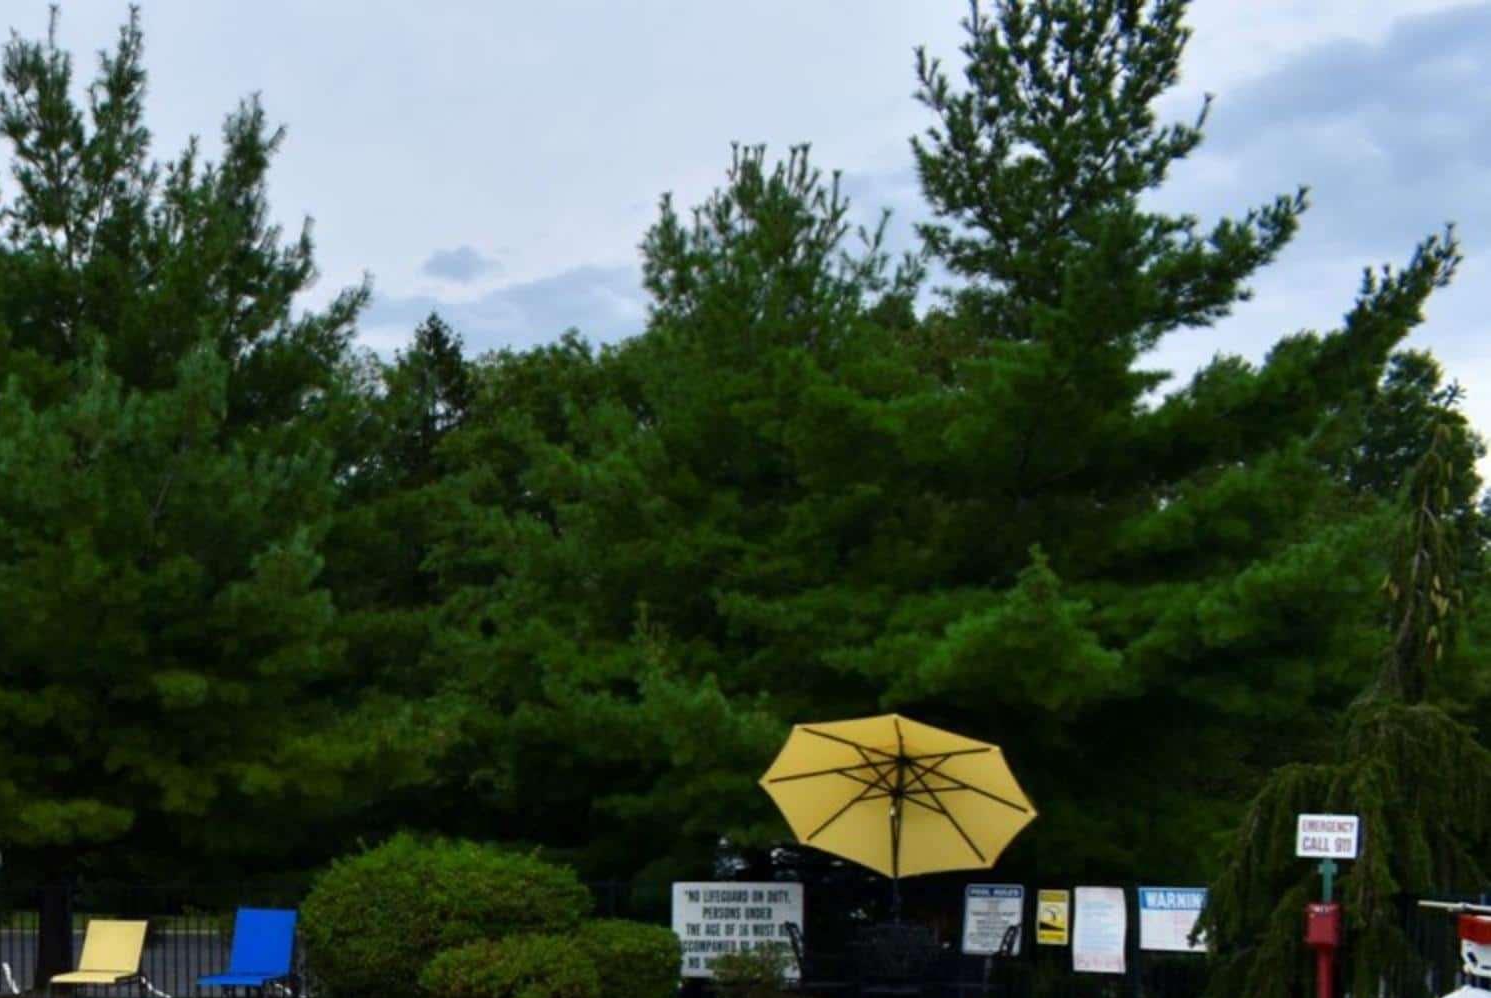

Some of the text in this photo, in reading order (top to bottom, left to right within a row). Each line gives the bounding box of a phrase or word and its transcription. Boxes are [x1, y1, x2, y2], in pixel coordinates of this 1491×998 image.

[1302, 836, 1329, 852] CALL
[703, 890, 749, 903] LIFEGUARD
[752, 890, 764, 902] ON
[702, 907, 772, 919] PERSONS UNDER
[686, 923, 701, 936] THE
[705, 923, 721, 936] AGE
[725, 923, 735, 936] OF
[753, 923, 775, 936] MUST
[682, 941, 737, 953] CCOMPANIED
